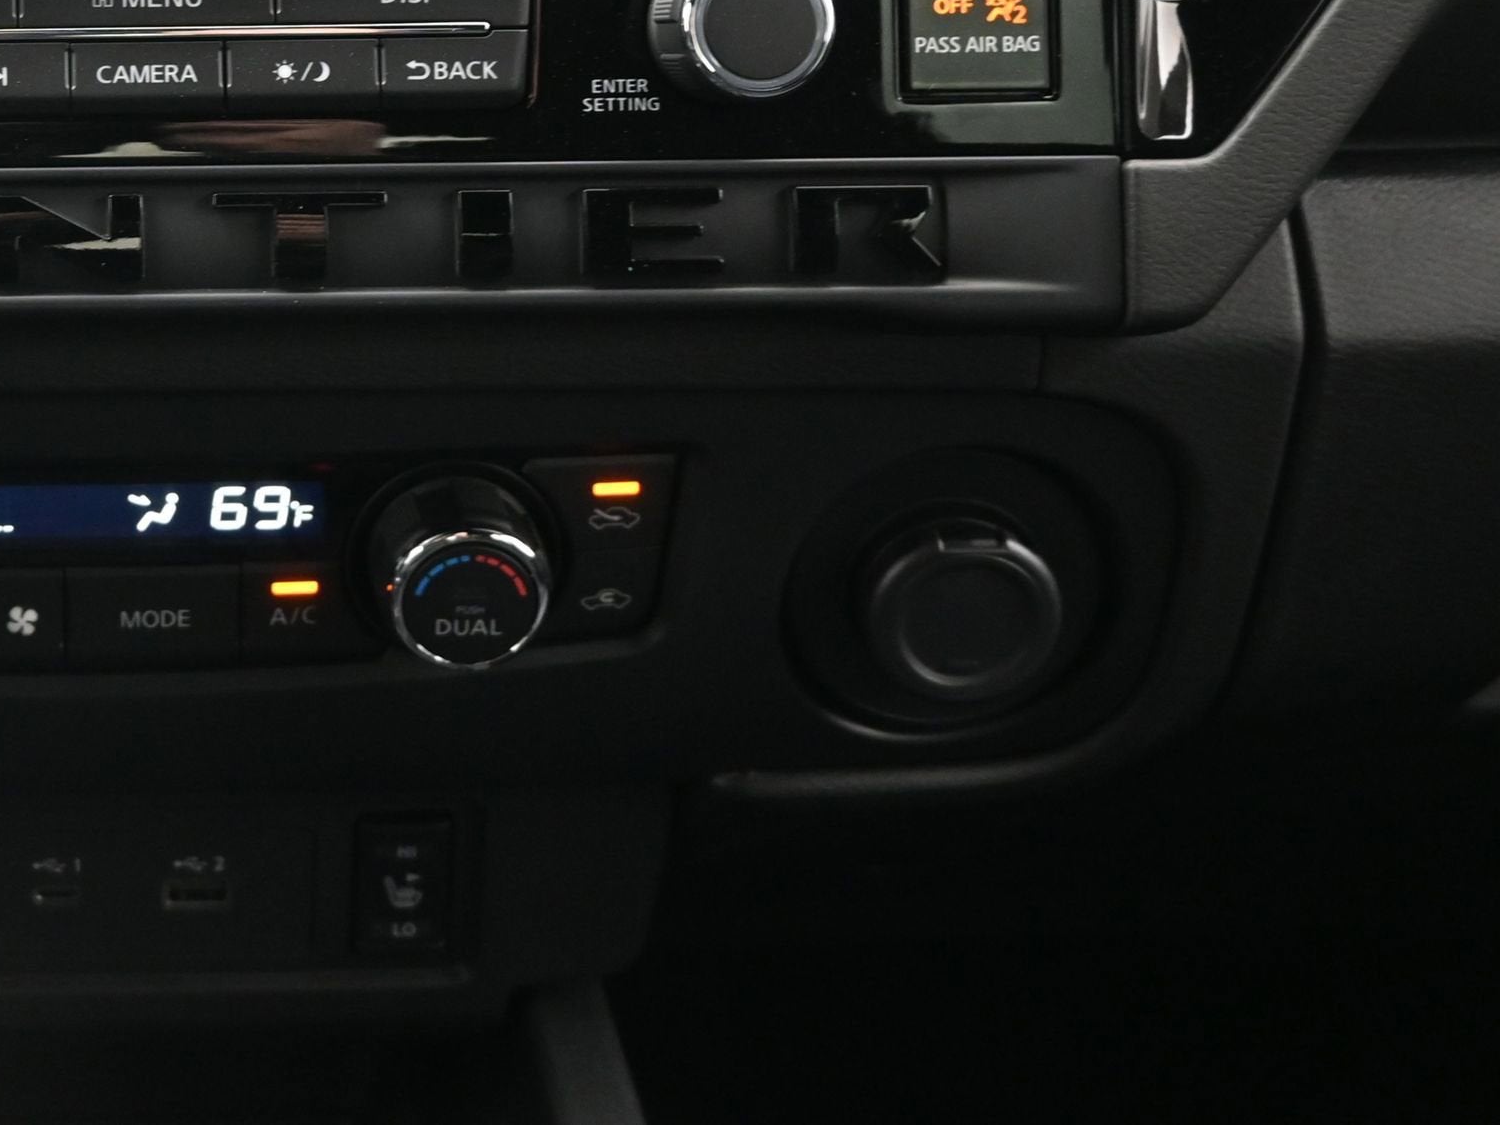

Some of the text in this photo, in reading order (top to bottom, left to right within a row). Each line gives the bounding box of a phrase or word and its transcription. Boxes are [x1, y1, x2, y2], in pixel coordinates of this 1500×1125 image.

[914, 36, 1041, 53] PASS AIR BAG
[97, 65, 198, 84] CAMERA
[434, 61, 498, 81] BACK
[591, 79, 649, 94] ENTER
[582, 98, 660, 113] SETTING
[120, 609, 191, 629] MODE
[270, 607, 316, 626] A/C
[435, 618, 503, 636] DUAL
[392, 922, 418, 937] LO
